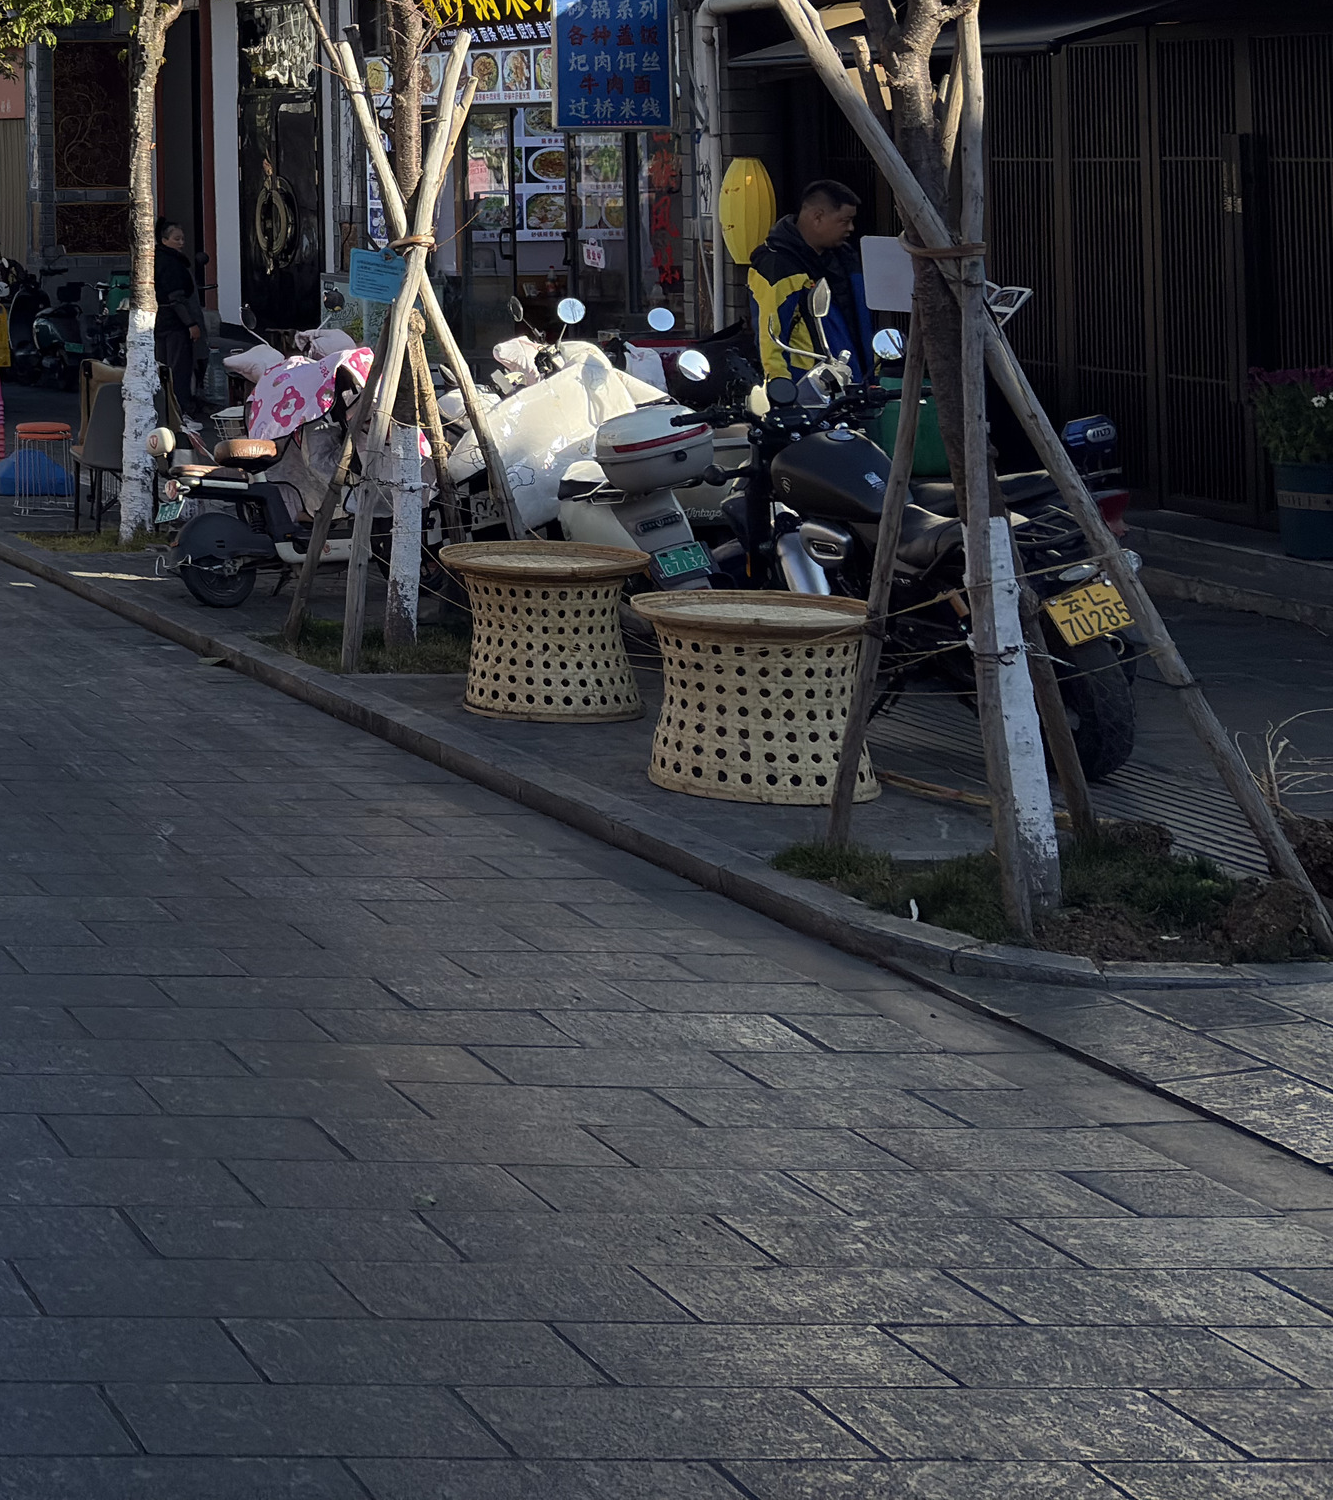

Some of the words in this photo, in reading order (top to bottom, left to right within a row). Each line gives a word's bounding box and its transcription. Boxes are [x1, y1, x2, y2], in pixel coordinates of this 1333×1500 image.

[568, 24, 660, 46] 各种盖饭
[579, 73, 651, 95] 牛肉面
[568, 98, 662, 119] 过桥米线
[683, 508, 723, 521] Vintage
[664, 554, 707, 574] C7132
[1060, 600, 1132, 641] 7U285
